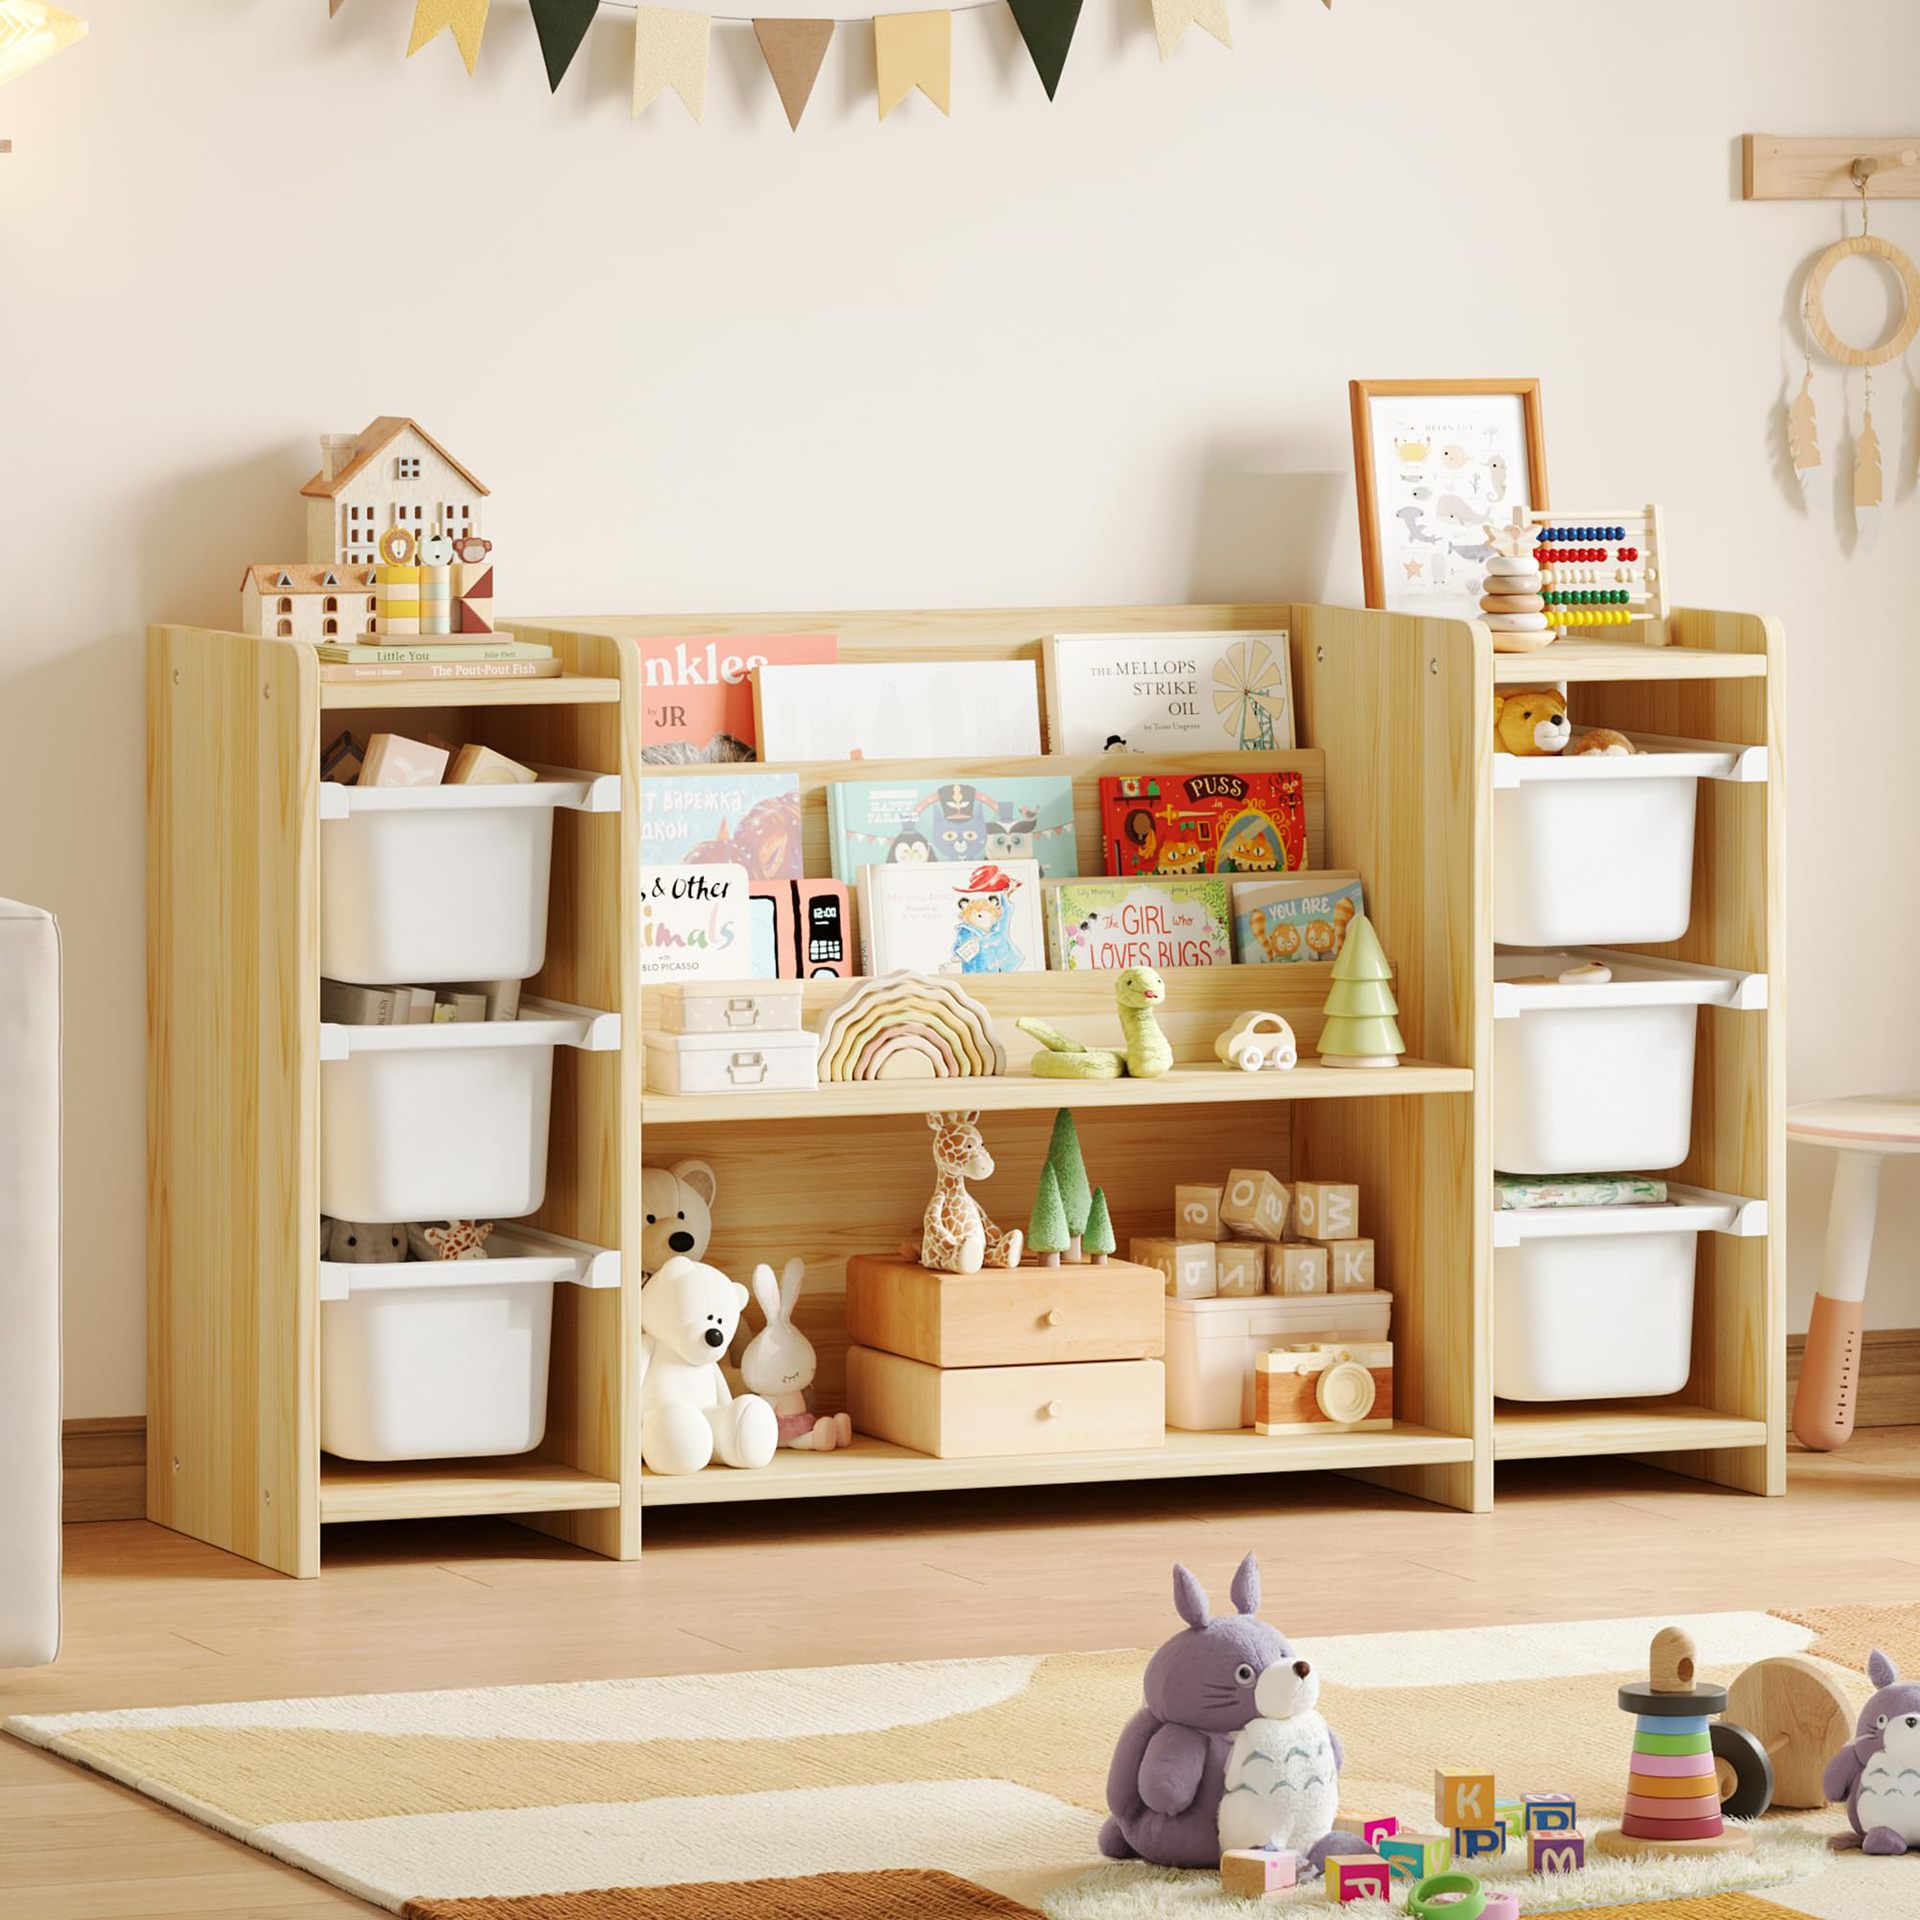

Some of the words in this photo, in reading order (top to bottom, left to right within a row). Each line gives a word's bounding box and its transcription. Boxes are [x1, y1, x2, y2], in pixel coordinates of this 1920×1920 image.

[377, 651, 405, 662] Little
[408, 651, 430, 661] You
[640, 642, 768, 686] nkles
[1090, 667, 1113, 677] THE
[1116, 660, 1197, 675] MELLOPS
[431, 665, 452, 677] The
[455, 664, 511, 676] Pout-Pout
[512, 663, 536, 675] Fish
[1133, 681, 1198, 696] STRIKE
[654, 705, 688, 728] JR
[1168, 701, 1200, 716] OIL
[1190, 776, 1242, 798] PUSS
[652, 877, 666, 898] &
[671, 875, 731, 901] Other
[1102, 913, 1120, 930] The
[1122, 904, 1171, 936] GIRL
[1268, 901, 1297, 920] YOU
[1301, 896, 1331, 915] ARE
[642, 903, 735, 951] imals
[641, 963, 660, 972] BLO
[661, 962, 700, 972] PICASSO
[1090, 941, 1155, 969] LOVES
[1158, 940, 1212, 968] BUGS
[1344, 1251, 1365, 1284] K
[1456, 1783, 1482, 1820] K
[1462, 1829, 1500, 1859] P
[1541, 1846, 1577, 1874] M
